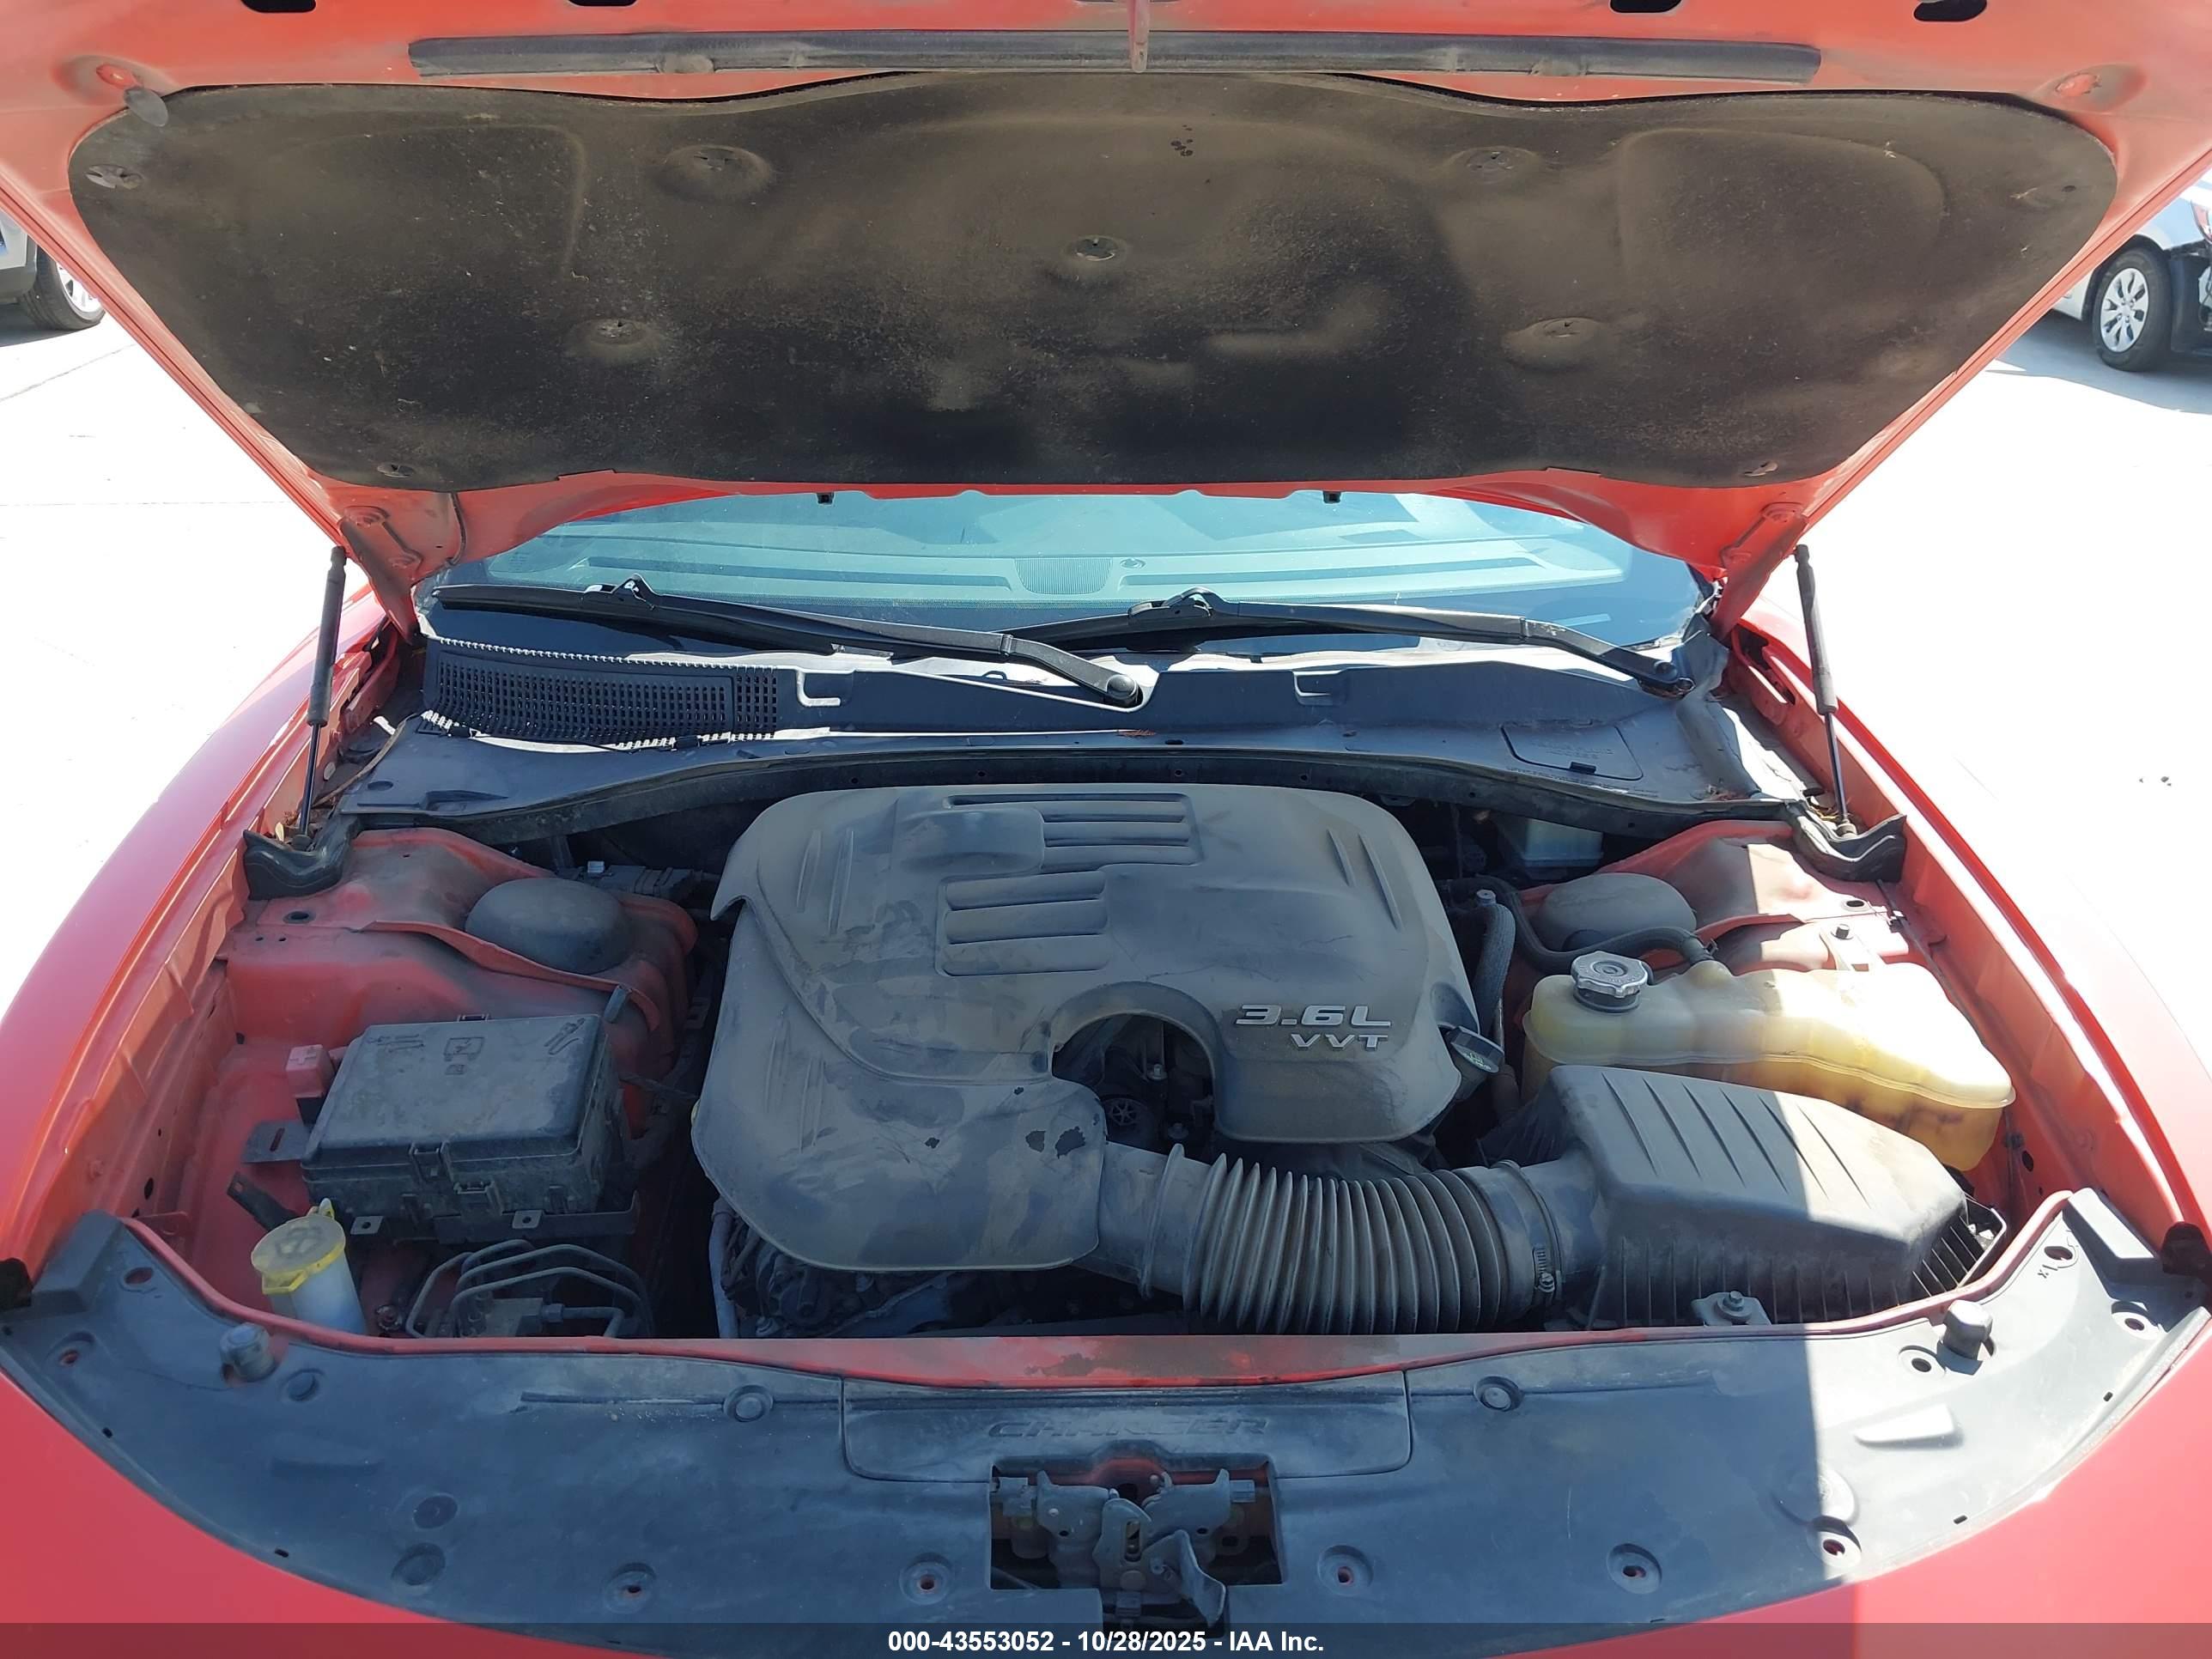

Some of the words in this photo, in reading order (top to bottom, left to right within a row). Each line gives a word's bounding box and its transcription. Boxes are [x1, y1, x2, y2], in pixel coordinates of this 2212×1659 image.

[1236, 1004, 1392, 1027] 3.6L
[1290, 1033, 1389, 1050] VVT
[988, 1418, 1270, 1438] CHARGER
